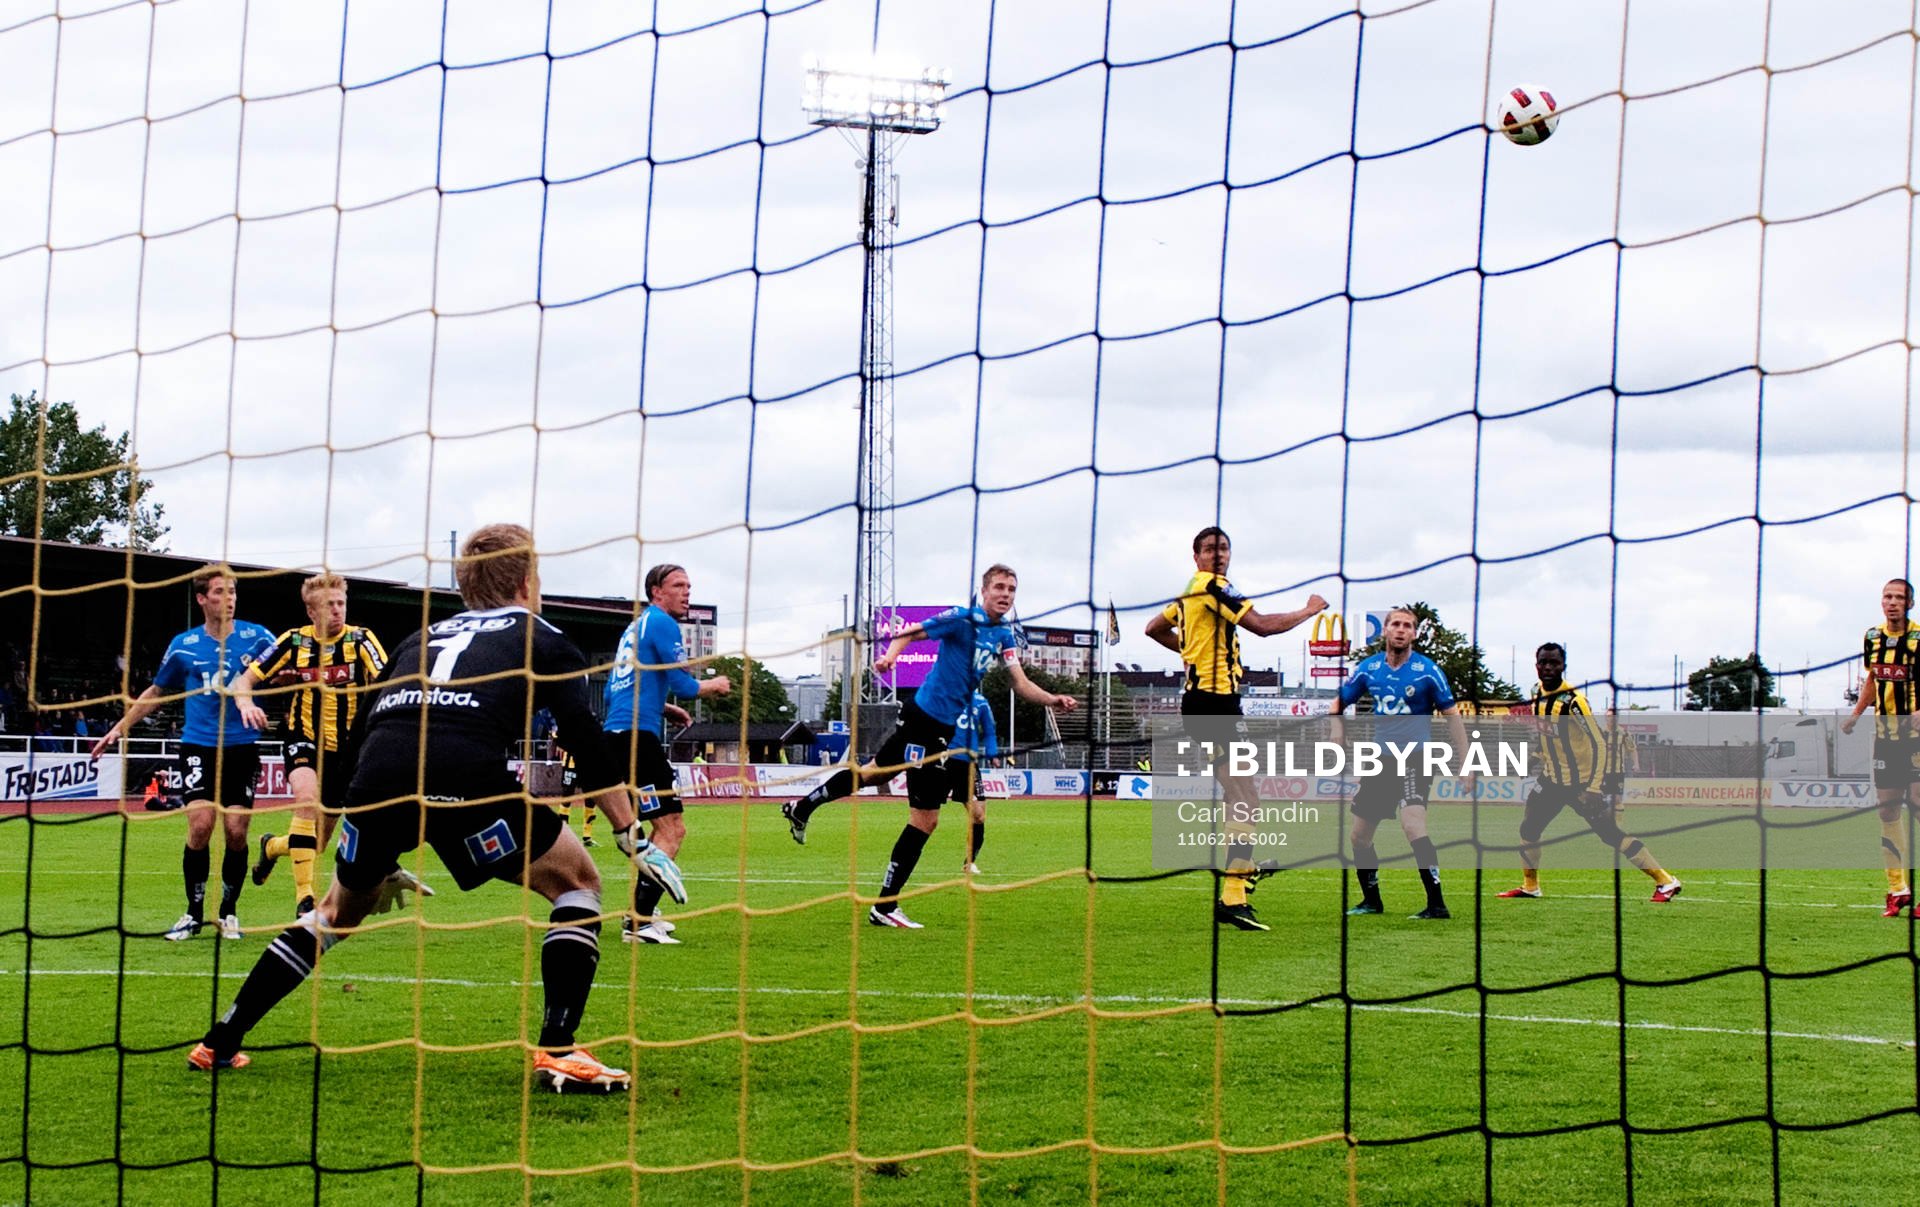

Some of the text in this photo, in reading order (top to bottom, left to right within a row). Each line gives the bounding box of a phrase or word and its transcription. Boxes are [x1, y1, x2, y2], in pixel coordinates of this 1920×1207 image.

[1374, 695, 1412, 715] ICA
[187, 756, 201, 766] 19
[5, 758, 99, 799] FRISTADS
[1055, 779, 1077, 789] WHC
[1252, 778, 1308, 799] ARO
[1779, 782, 1872, 798] VOLV
